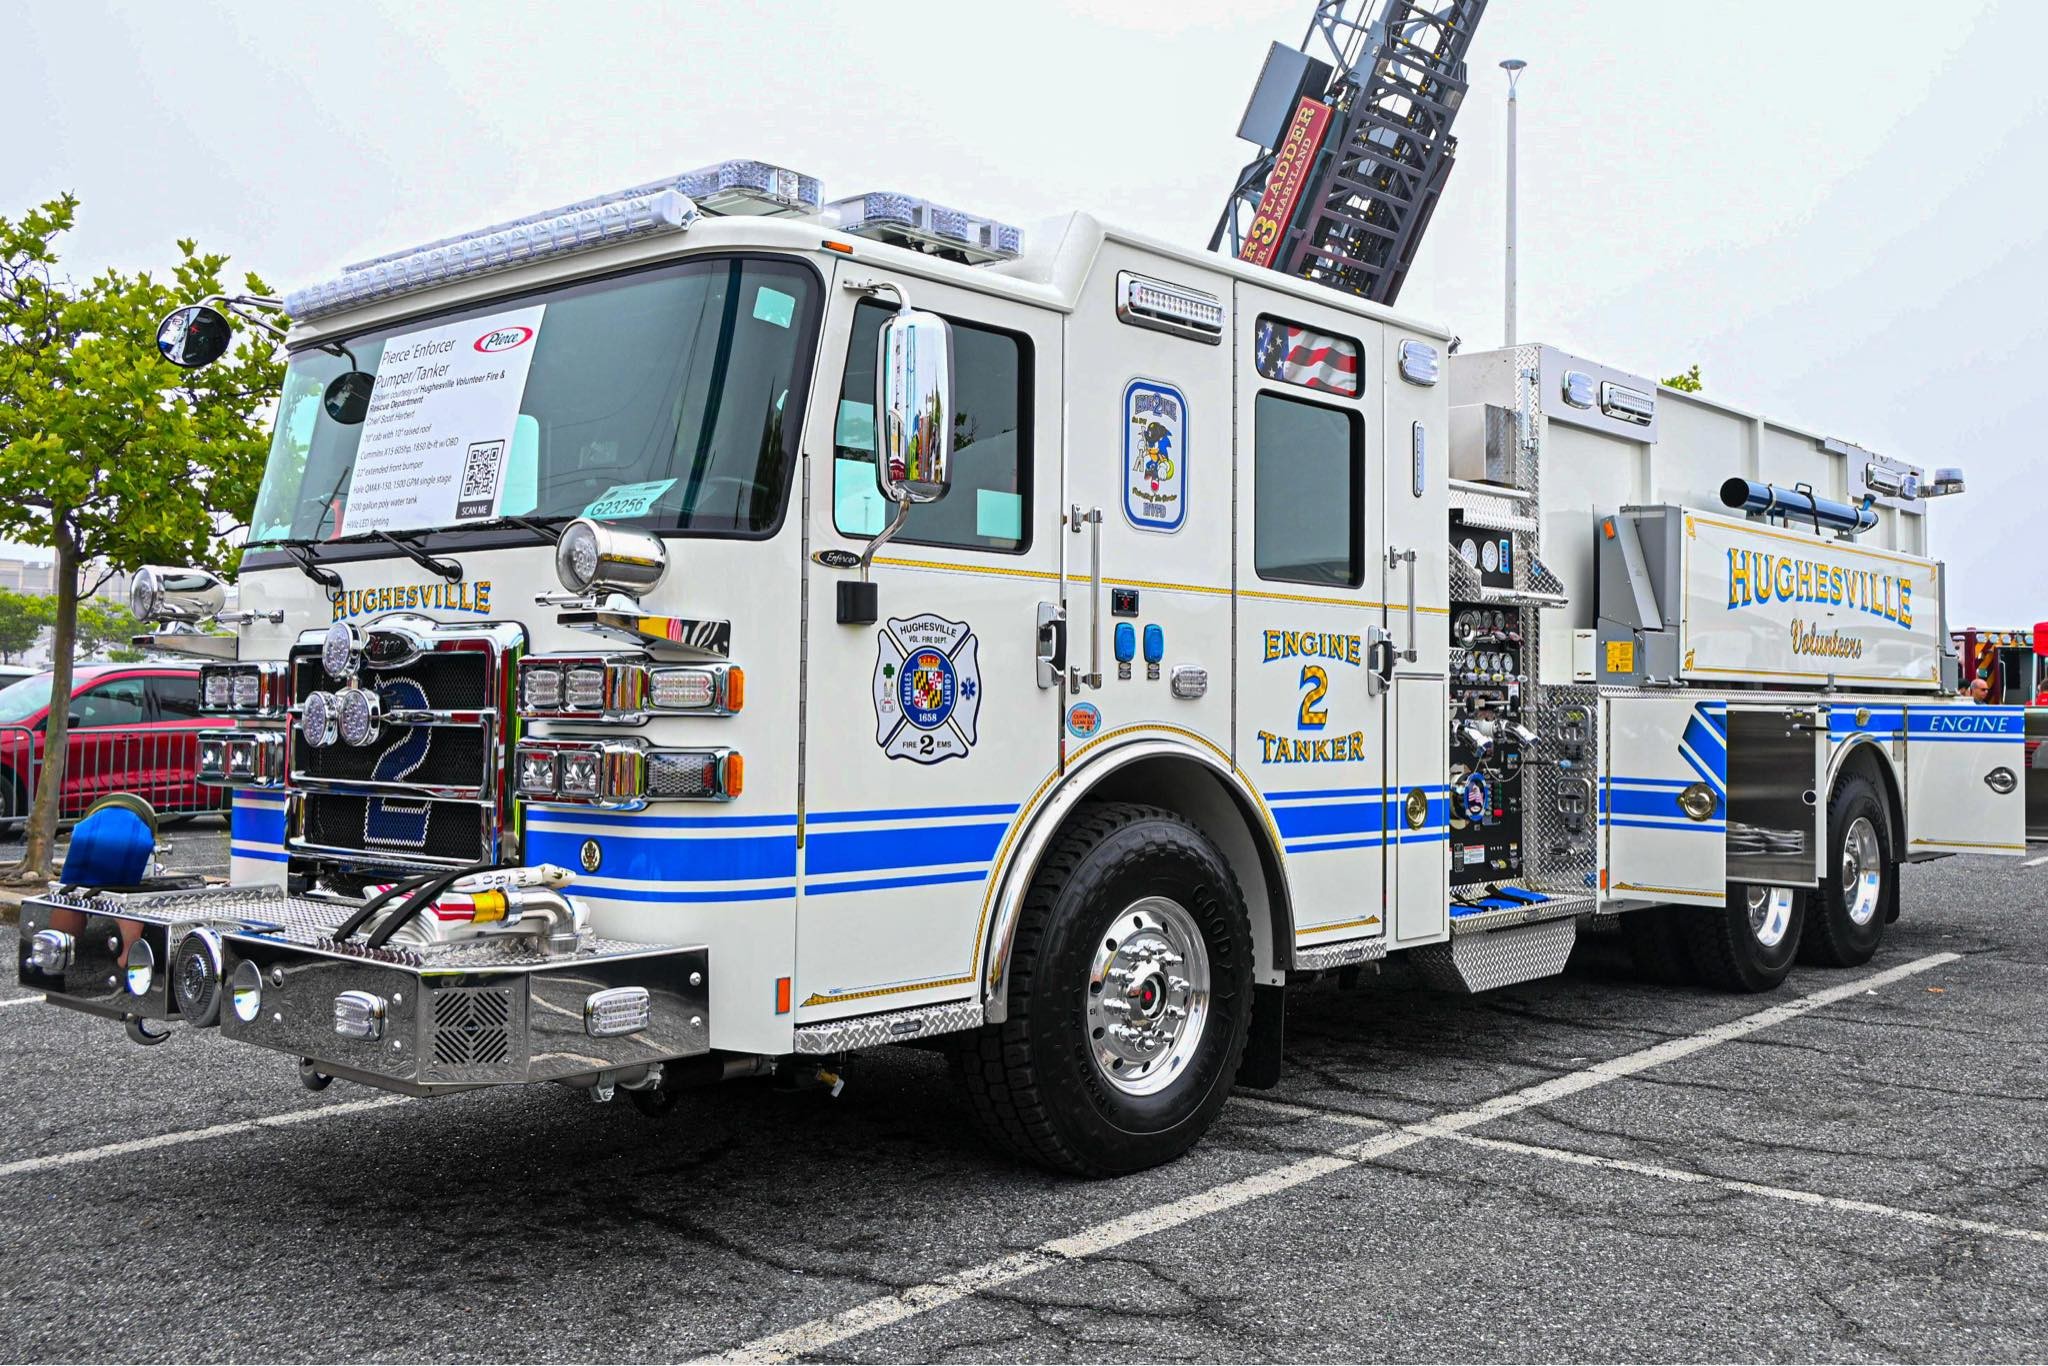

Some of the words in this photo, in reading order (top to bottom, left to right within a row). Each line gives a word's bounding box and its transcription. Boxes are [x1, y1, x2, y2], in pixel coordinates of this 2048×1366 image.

[1261, 107, 1315, 214] LADDER
[1274, 138, 1311, 220] MARYLAND
[1252, 216, 1278, 246] 3
[413, 339, 456, 359] Enforcer
[485, 332, 519, 350] Pierce
[375, 364, 450, 390] Pumper/Tanker
[420, 379, 455, 394] Hughesville
[456, 373, 485, 387] Volunteer
[486, 371, 499, 381] Fire
[499, 369, 506, 379] &
[369, 400, 389, 413] Rescue
[390, 396, 424, 409] Department
[383, 429, 394, 440] with
[403, 425, 420, 436] raised
[420, 424, 432, 435] roof
[365, 464, 389, 476] extended
[389, 462, 402, 473] front
[401, 460, 424, 473] bumper
[420, 475, 436, 488] single
[436, 474, 452, 485] stage
[405, 495, 418, 506] tank
[461, 506, 477, 517] SCAN
[477, 504, 488, 514] ME
[590, 497, 647, 516] G23256
[1727, 548, 1913, 631] HUGHESVILLE
[331, 581, 492, 623] HUGHESVILLE
[899, 622, 957, 638] HUGHESVILLE
[909, 635, 920, 643] VOL.
[921, 636, 933, 644] FIRE
[934, 637, 947, 645] DEPT.
[1790, 618, 1862, 660] Volunteers
[1263, 630, 1361, 667] ENGINE
[904, 672, 912, 706] CHARLES
[944, 673, 952, 706] COUNTY
[1298, 664, 1328, 731] 2
[918, 713, 938, 723] 1658
[1929, 715, 2010, 733] ENGINE
[902, 741, 917, 749] FIRE
[919, 734, 935, 756] 2
[937, 740, 952, 749] EMS
[1257, 730, 1365, 764] TANKER
